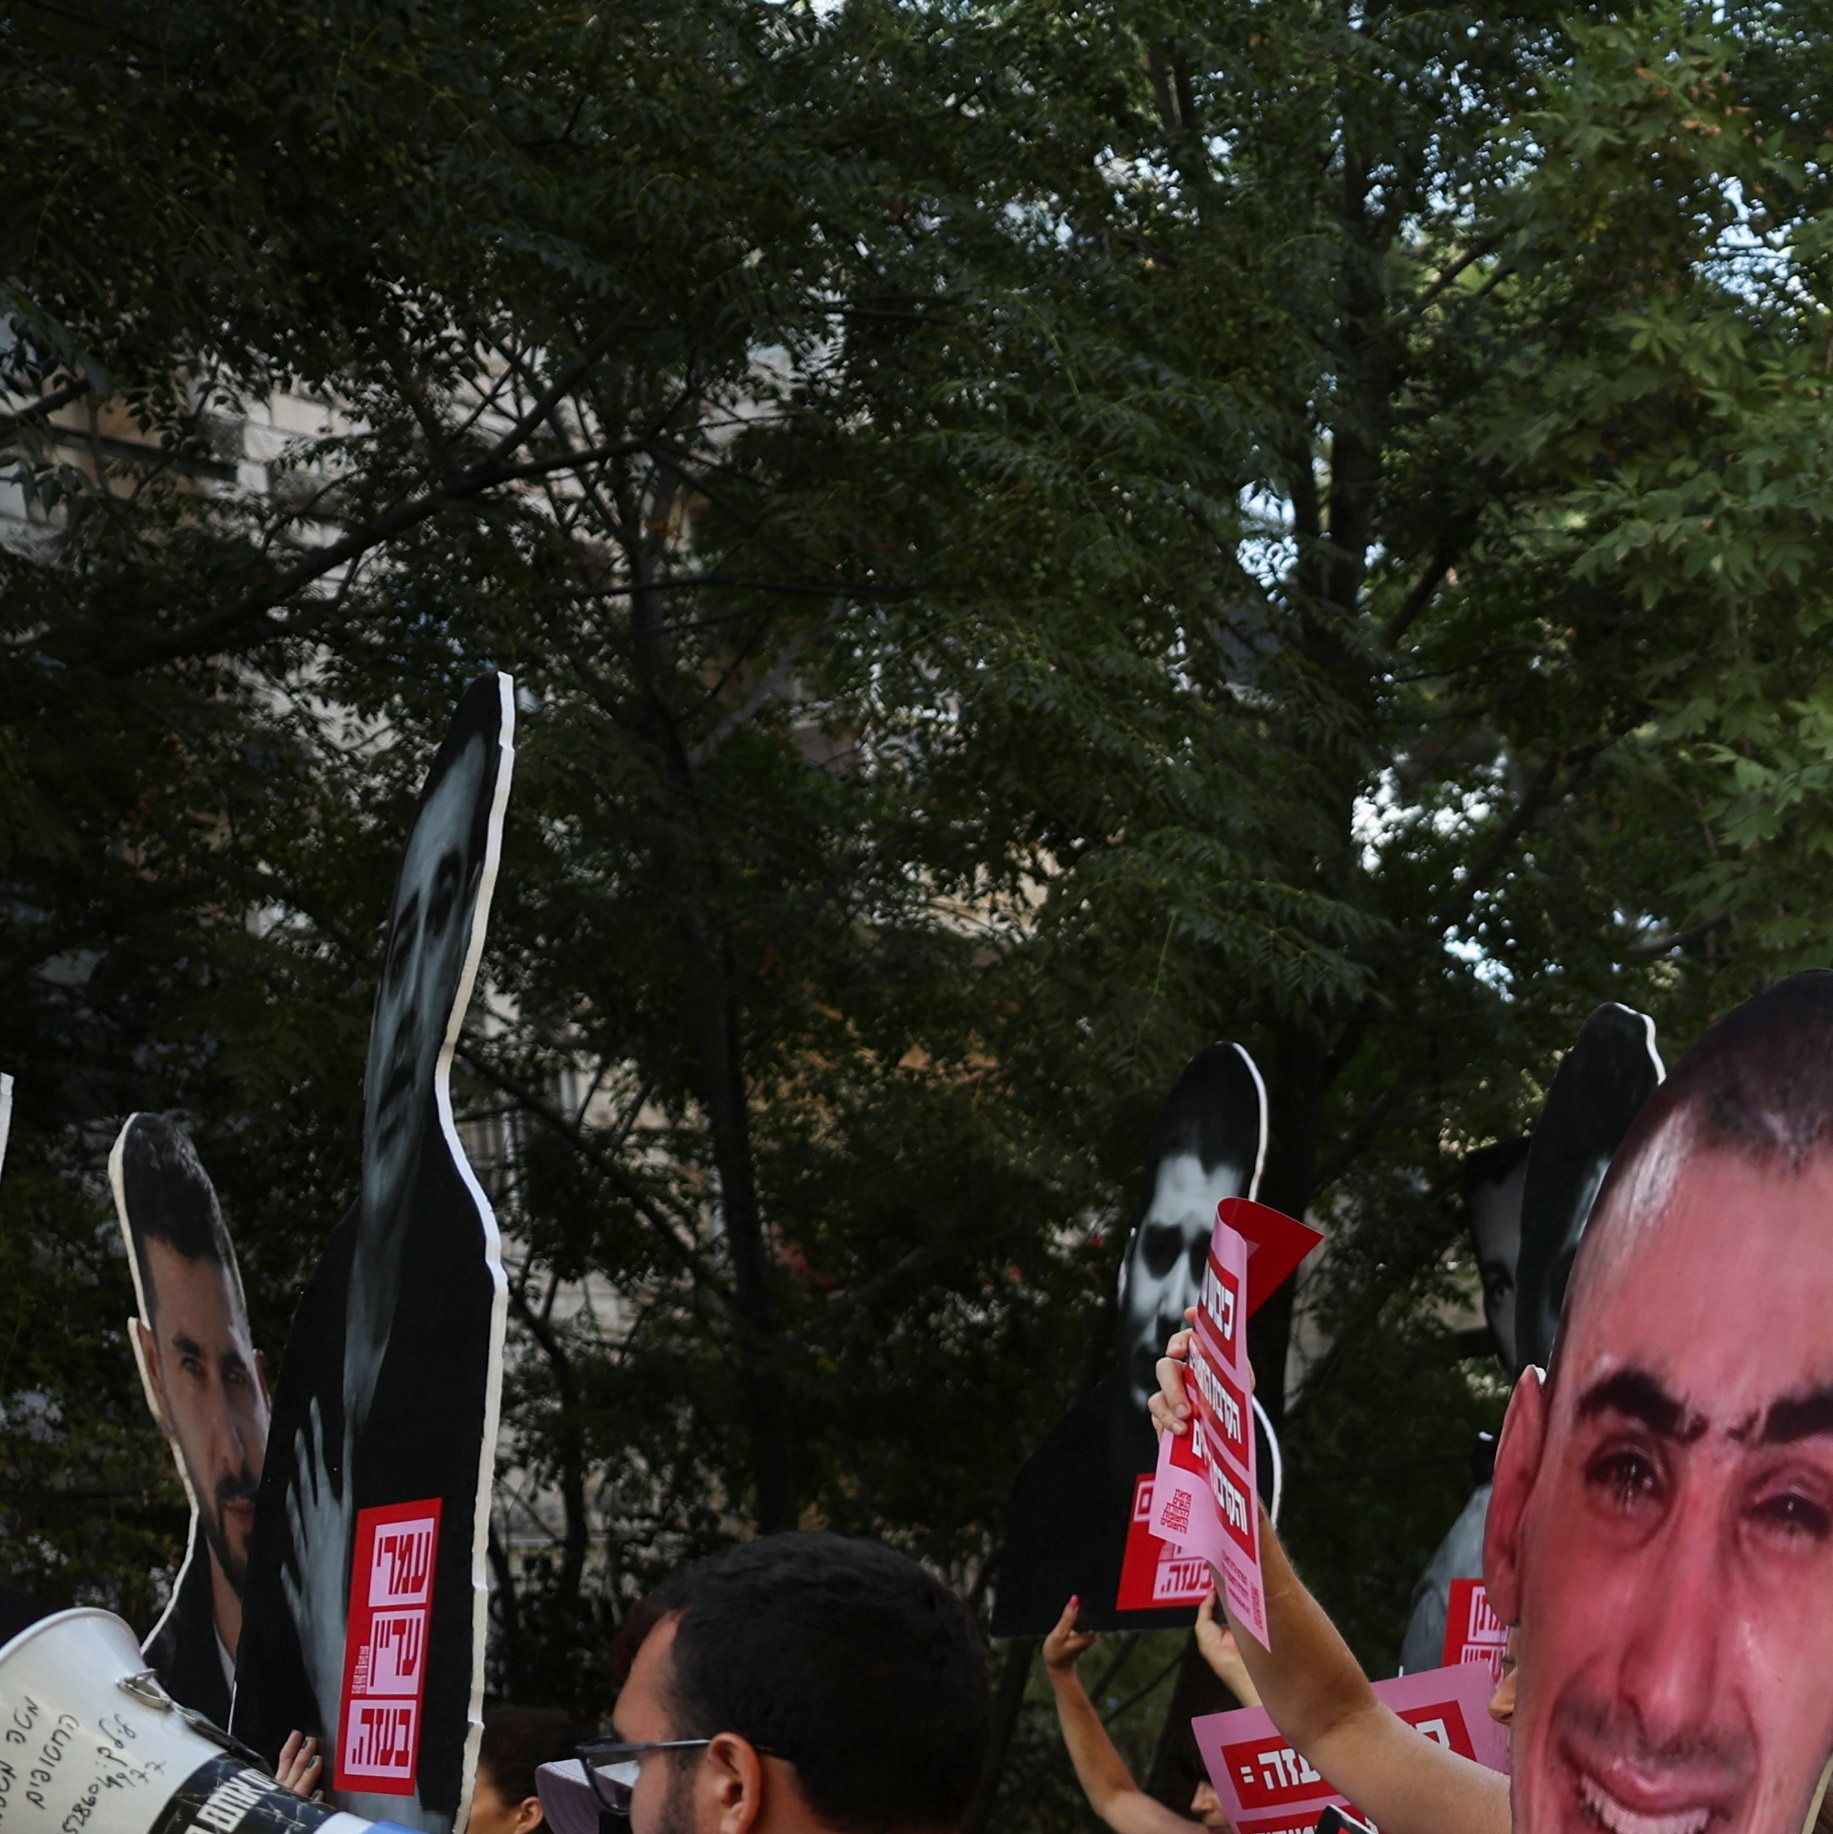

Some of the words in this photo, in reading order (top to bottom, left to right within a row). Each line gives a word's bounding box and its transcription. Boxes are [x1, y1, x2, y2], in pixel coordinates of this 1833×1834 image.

[376, 1531, 431, 1596] עמרי
[369, 1617, 421, 1688] עדיין
[26, 1714, 80, 1811] החטופים
[351, 1707, 412, 1768] בעזה.
